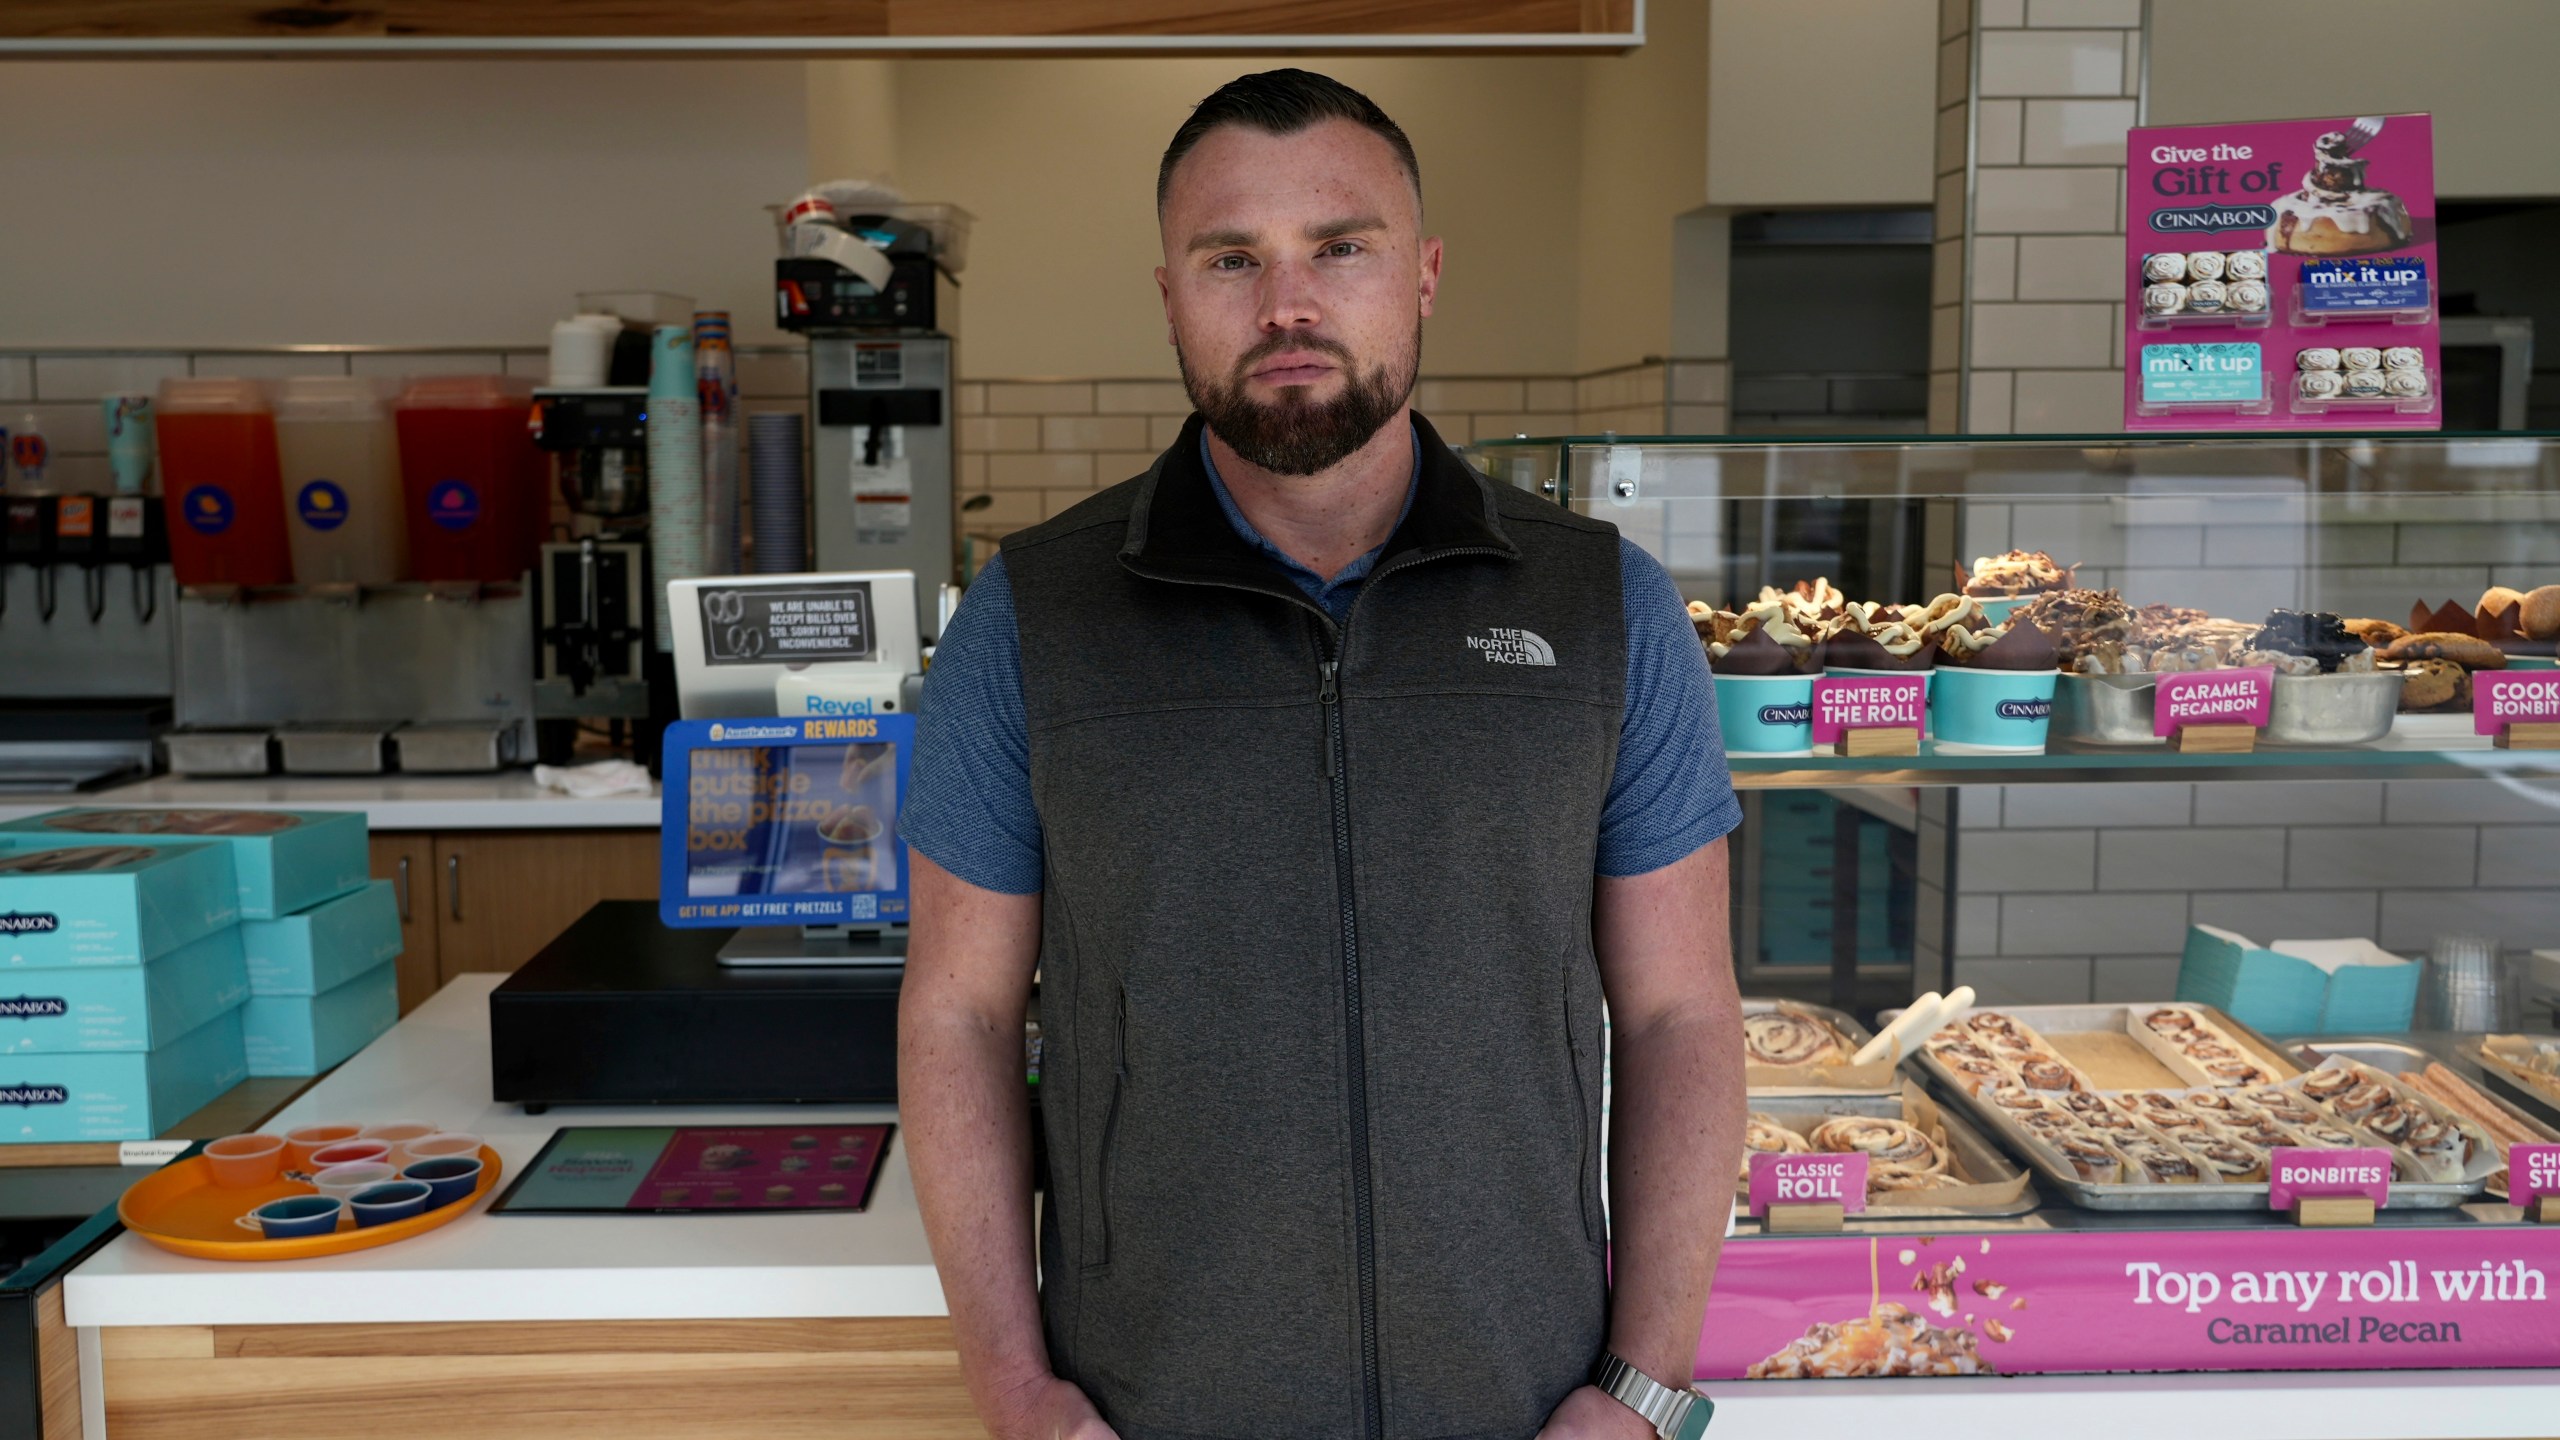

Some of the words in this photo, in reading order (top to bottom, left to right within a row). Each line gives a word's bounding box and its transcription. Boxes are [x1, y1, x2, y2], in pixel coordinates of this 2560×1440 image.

[2151, 146, 2207, 163] Give
[2211, 143, 2253, 161] the
[2152, 165, 2230, 196] Gift
[2240, 162, 2283, 193] of
[2155, 209, 2268, 229] CINNABON
[2311, 267, 2356, 284] mix
[2360, 267, 2379, 282] it
[2383, 269, 2418, 286] up
[2149, 353, 2194, 372] mix
[2198, 352, 2215, 371] it
[2220, 357, 2254, 376] up
[769, 602, 784, 612] WE
[786, 601, 805, 612] ARE
[806, 600, 841, 611] UNABLE
[843, 600, 855, 611] TO
[769, 614, 804, 625] ACCEPT
[806, 613, 832, 624] BILLS
[833, 612, 858, 623] OVER
[790, 626, 820, 637] SORRY
[822, 625, 841, 636] FOR
[843, 624, 859, 635] THE
[1489, 628, 1522, 640] THE
[1466, 636, 1524, 652] NORTH
[1485, 651, 1527, 665] FACE
[1821, 688, 1891, 704] CENTER
[1895, 687, 1918, 702] OF
[2170, 680, 2259, 701] CARAMEL
[2492, 682, 2560, 701] COOK
[806, 695, 872, 715] Revel
[1821, 706, 1862, 724] THE
[1867, 704, 1918, 722] ROLL
[2169, 697, 2258, 717] PECANBON
[2493, 701, 2560, 716] BONBIT
[804, 719, 877, 739] REWARDS
[690, 768, 812, 797] outside
[690, 798, 742, 823] the
[748, 795, 832, 829] pizza
[689, 825, 748, 851] box
[679, 906, 698, 918] GET
[700, 905, 718, 917] THE
[720, 904, 740, 916] APP
[742, 905, 761, 916] GET
[794, 902, 843, 914] PRETZELS
[0, 917, 53, 931] NABON
[2528, 1152, 2560, 1168] CH
[1775, 1163, 1844, 1177] CLASSIC
[2280, 1166, 2382, 1184] BONBITES
[1778, 1178, 1842, 1198] ROLL
[2126, 1262, 2220, 1313] Top
[2231, 1271, 2328, 1312] any
[2337, 1260, 2420, 1303] roll
[2430, 1260, 2546, 1301] with
[2207, 1316, 2350, 1345] Caramel
[2358, 1317, 2462, 1344] Pecan
